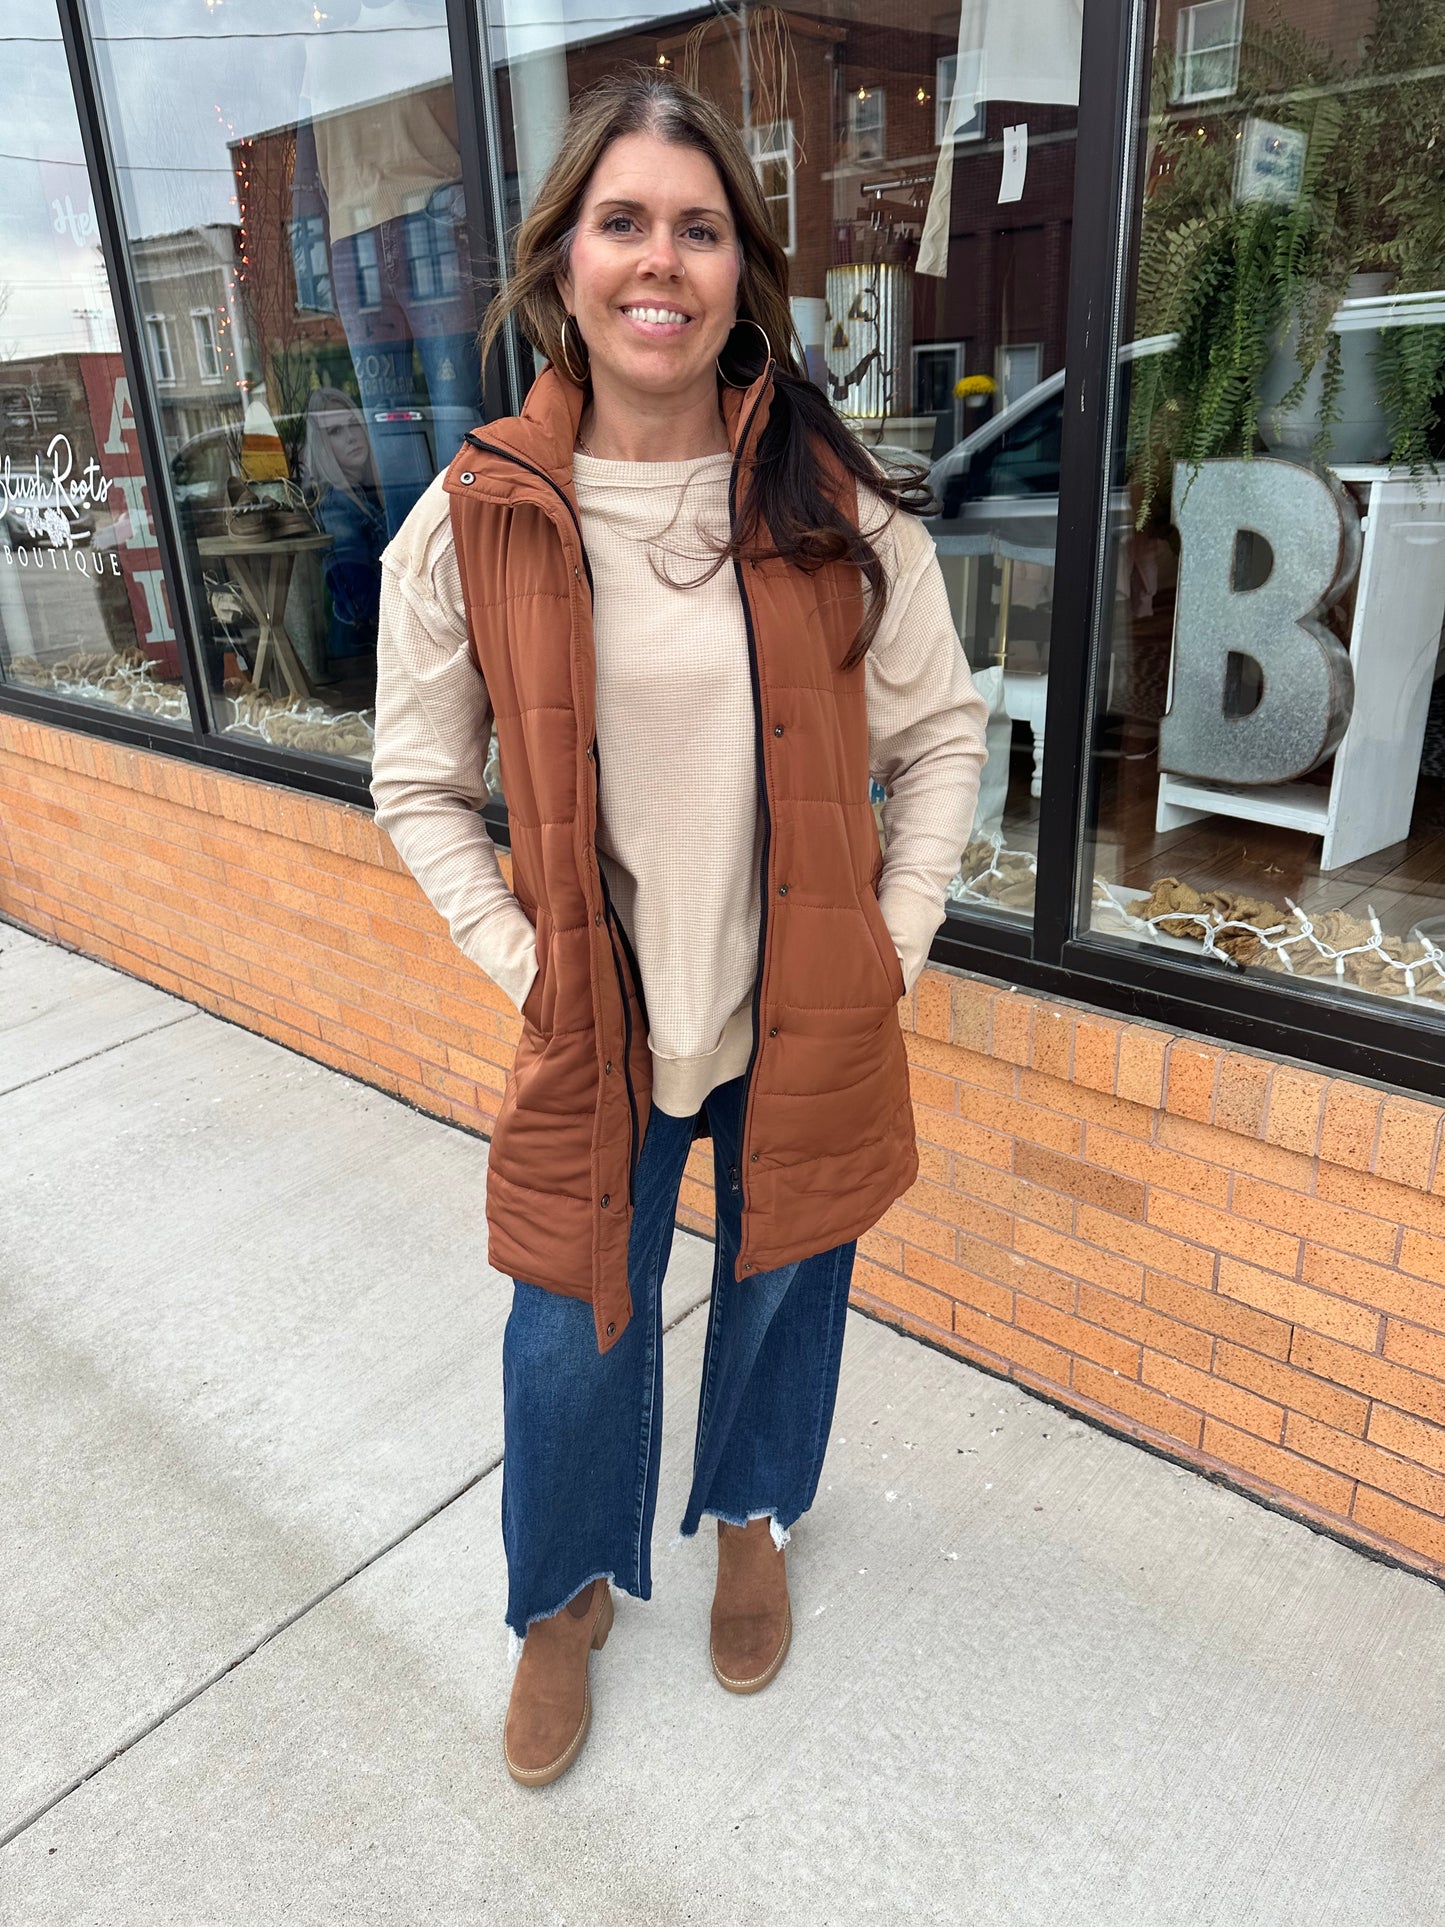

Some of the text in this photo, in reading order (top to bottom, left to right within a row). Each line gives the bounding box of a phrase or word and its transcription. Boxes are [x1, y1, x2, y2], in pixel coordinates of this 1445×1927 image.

[46, 433, 113, 518] Roots
[4, 545, 121, 578] BOUTIQUE
[1158, 457, 1358, 786] B
